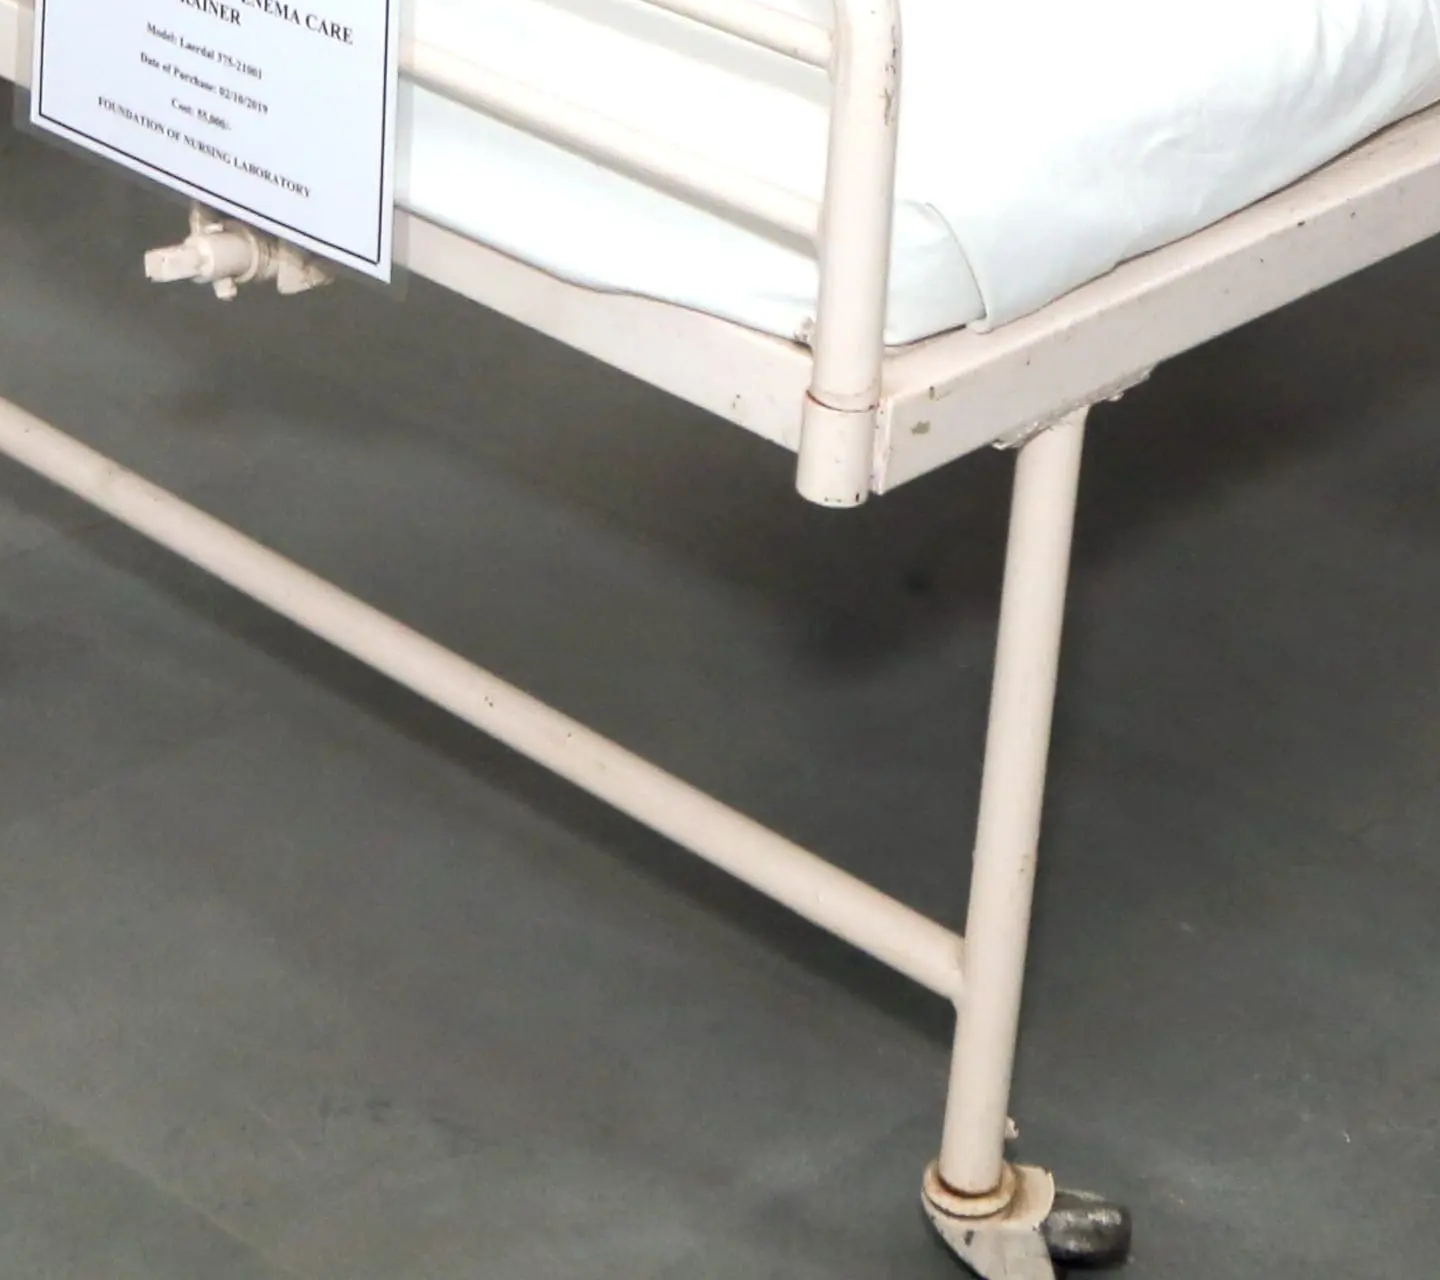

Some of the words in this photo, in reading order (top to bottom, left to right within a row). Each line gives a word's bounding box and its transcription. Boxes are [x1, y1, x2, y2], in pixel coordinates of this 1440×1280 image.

[146, 21, 177, 44] Model:
[179, 37, 215, 60] Laerdal
[305, 13, 354, 45] CARE
[140, 52, 160, 69] Date
[162, 63, 172, 73] of
[98, 95, 166, 137] FOUNDATION
[167, 127, 182, 142] OF
[183, 134, 232, 165] NURSING
[233, 156, 311, 199] LABORATORY
